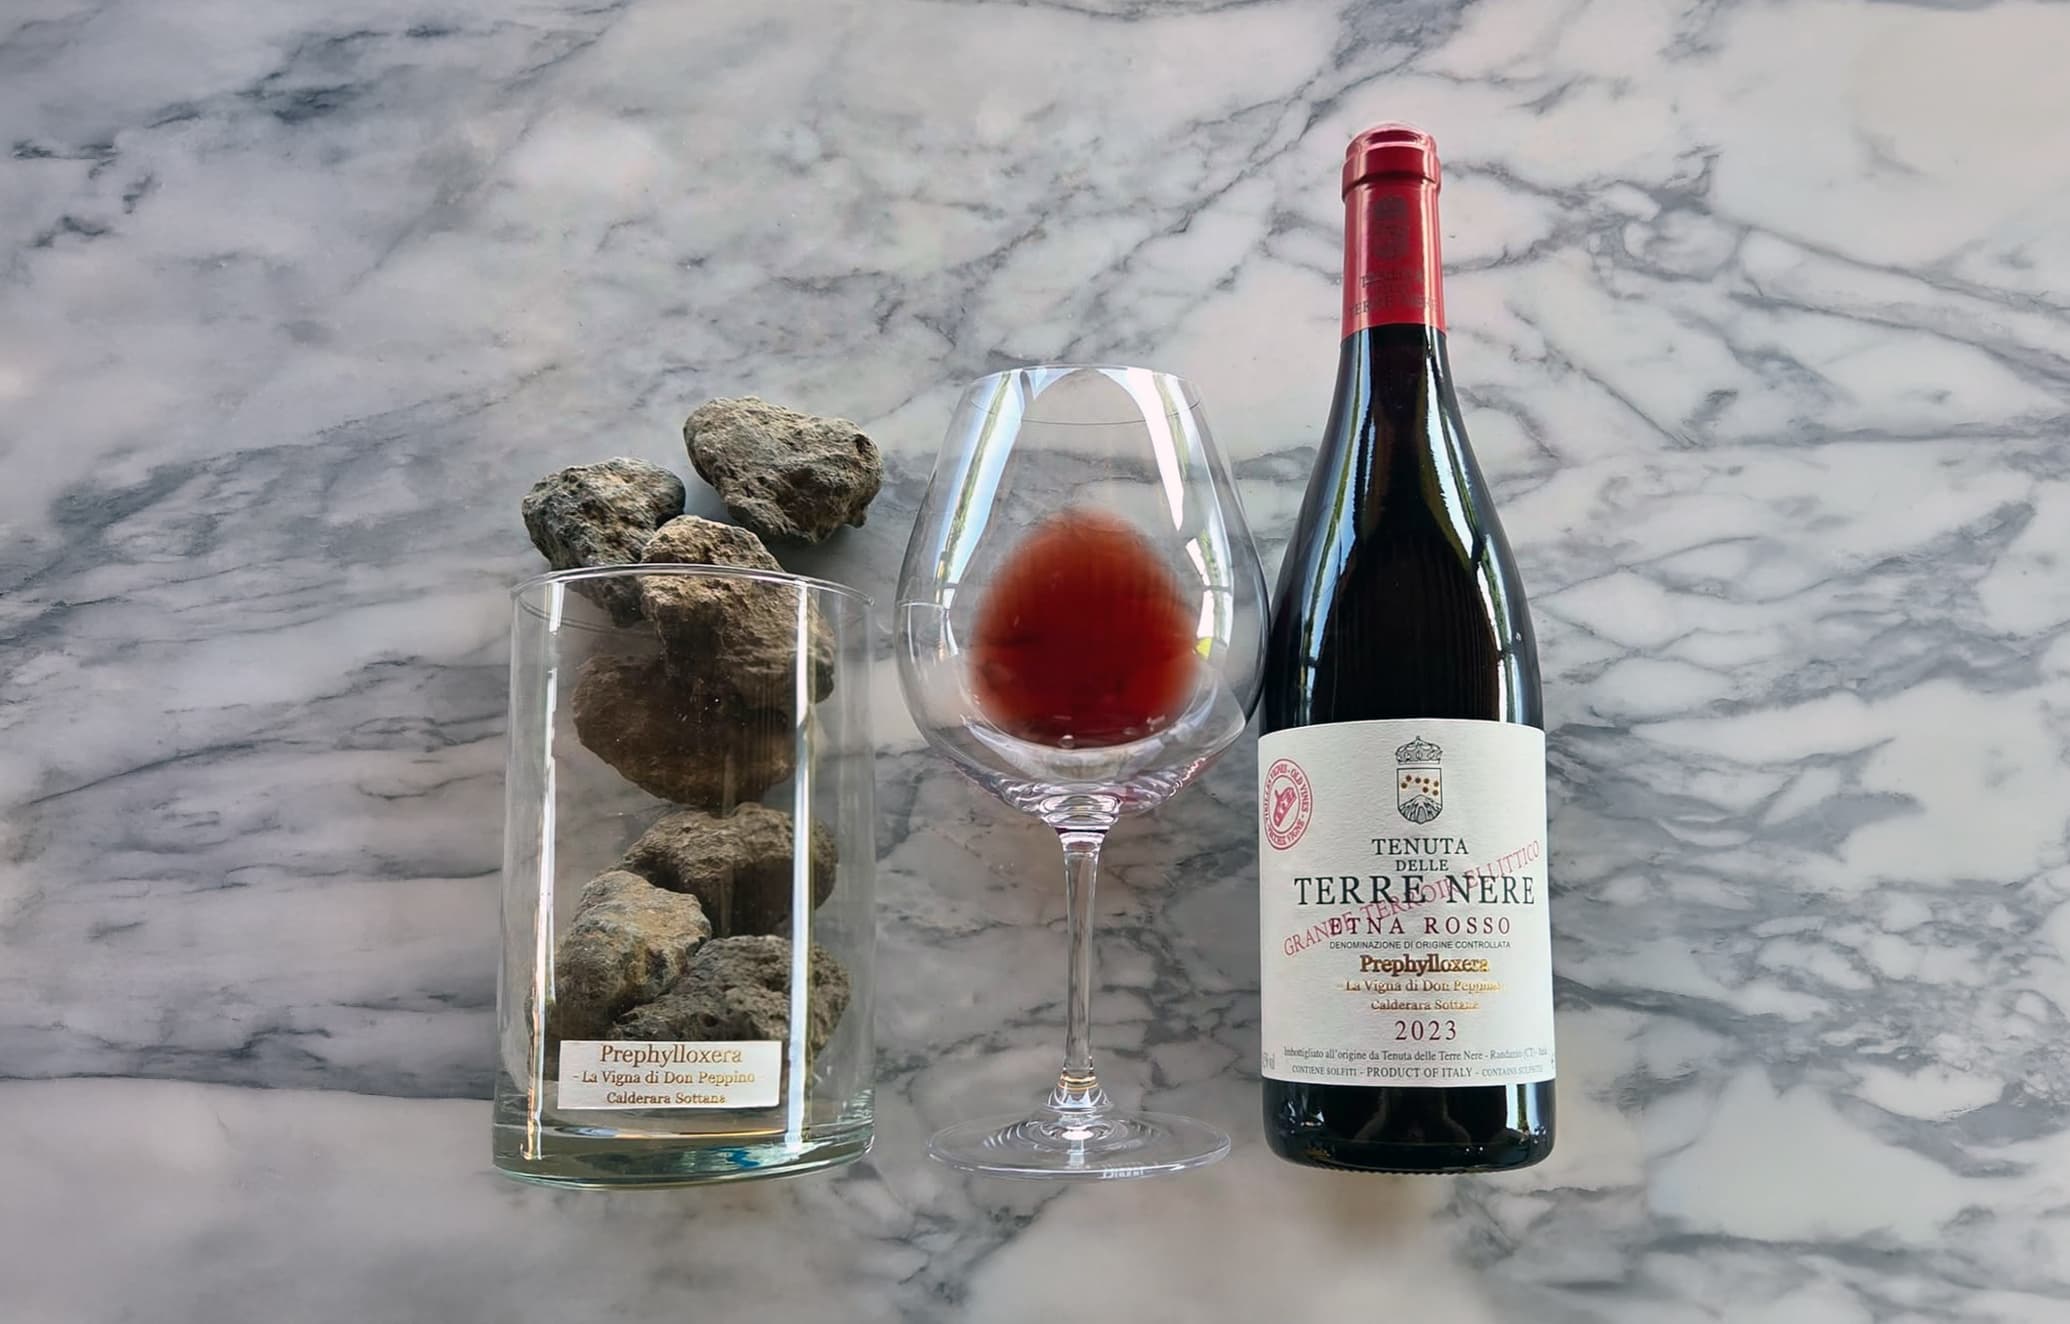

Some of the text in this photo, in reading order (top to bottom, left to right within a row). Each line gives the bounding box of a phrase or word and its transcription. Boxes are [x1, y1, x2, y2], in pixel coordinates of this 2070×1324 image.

[1371, 838, 1469, 855] TENUTA
[1395, 859, 1448, 871] DELLE
[1294, 875, 1534, 905] TERRE NERE
[1284, 911, 1354, 956] GRANDE
[1329, 916, 1510, 935] ETNA ROSSO
[1329, 941, 1511, 949] DENOMINAZIONE DI ORIGINE CONTROLLATA
[1360, 953, 1489, 977] Prephylloxera
[1346, 980, 1361, 992] La
[1364, 980, 1401, 993] Vigna
[1405, 979, 1419, 992] di
[1423, 980, 1449, 992] Don
[1371, 1000, 1430, 1010] Calderara
[1395, 1020, 1457, 1041] 2023
[600, 1043, 742, 1067] Prephylloxera
[1368, 1050, 1380, 1060] da
[1381, 1050, 1412, 1061] Tenuta
[1412, 1050, 1436, 1061] delle
[1438, 1050, 1461, 1061] Terre
[1463, 1050, 1483, 1060] Nere
[582, 1071, 597, 1084] La
[602, 1070, 640, 1087] Vigna
[645, 1070, 659, 1084] di
[664, 1071, 693, 1084] Don
[699, 1070, 755, 1087] Peppino
[1291, 1065, 1325, 1075] CONTIENE
[1326, 1066, 1357, 1076] SOLFITI
[1367, 1066, 1420, 1078] PRODUCT
[1423, 1067, 1439, 1078] OF
[1442, 1067, 1472, 1078] ITALY
[606, 1092, 726, 1104] Calderara Sottana
